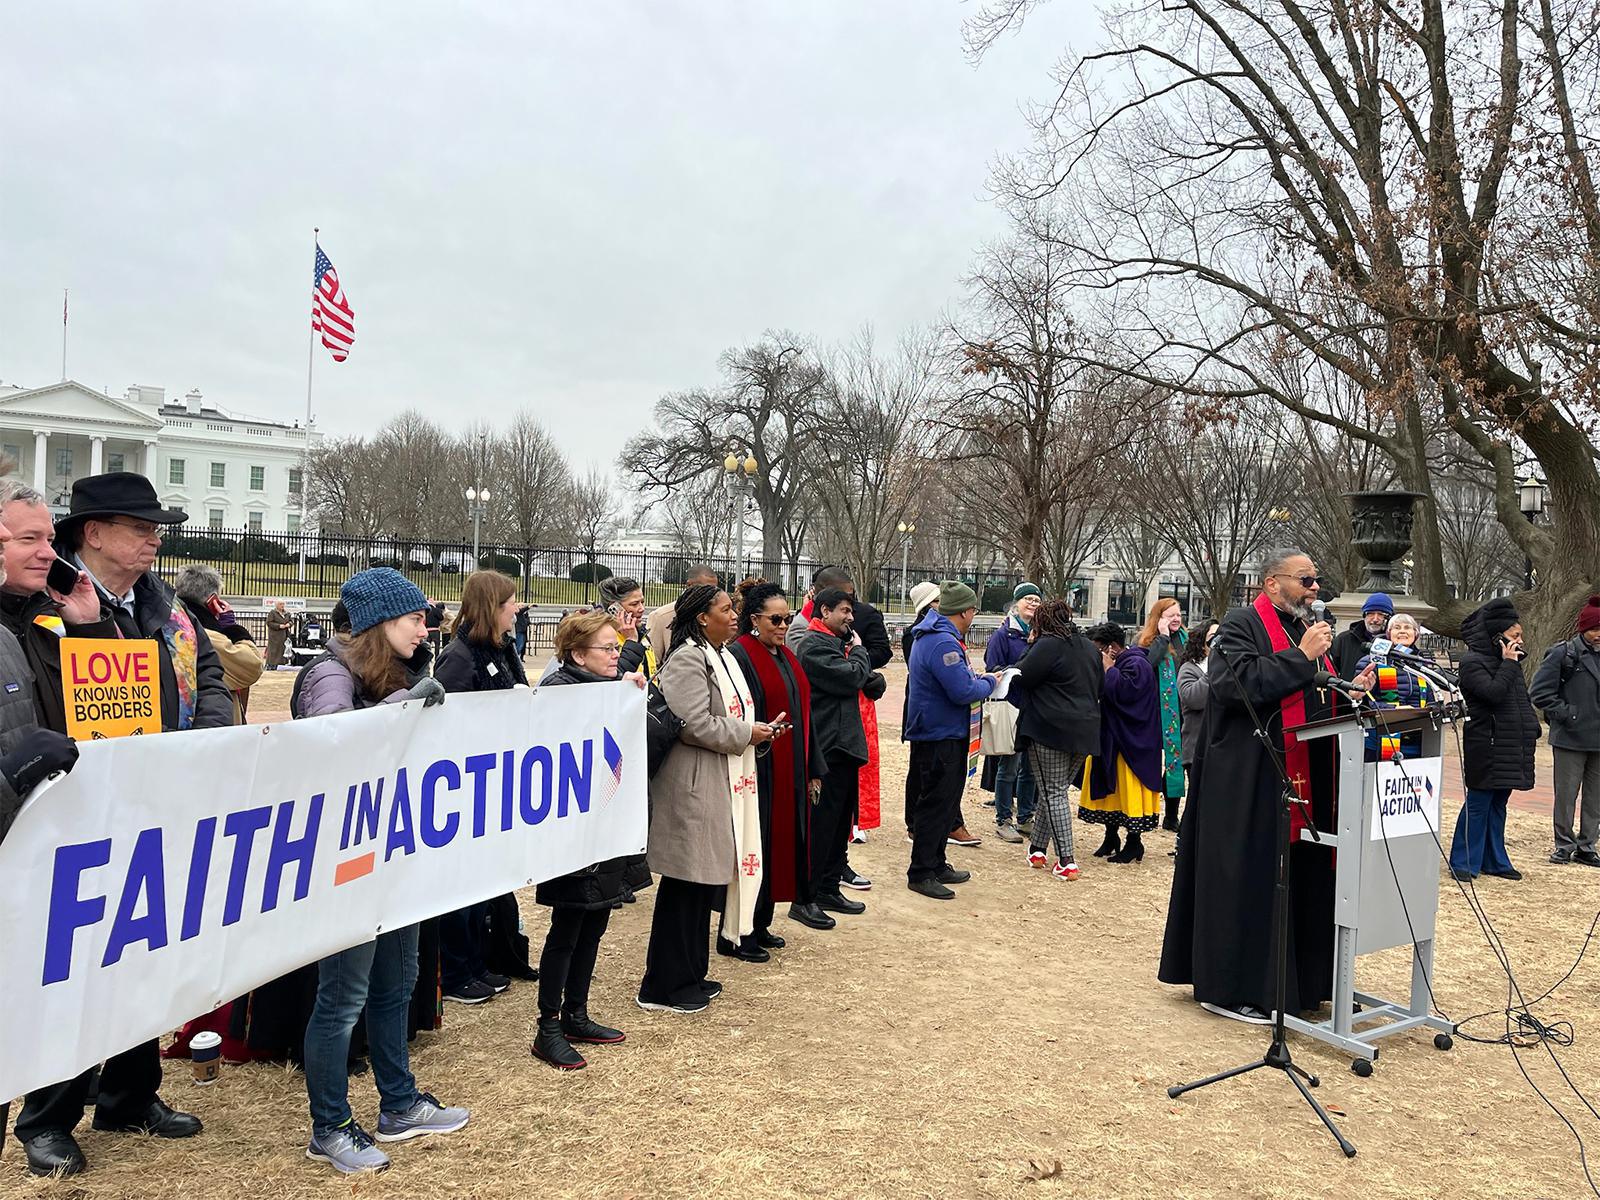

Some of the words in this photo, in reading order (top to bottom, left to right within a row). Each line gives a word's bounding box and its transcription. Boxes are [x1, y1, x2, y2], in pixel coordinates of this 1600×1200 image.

[71, 652, 150, 684] LOVE
[73, 686, 129, 702] KNOWS
[131, 685, 151, 700] NO
[75, 701, 153, 722] BORDERS
[1385, 776, 1414, 796] FAITH
[1414, 776, 1422, 787] IN
[1382, 795, 1421, 816] ACTION
[42, 793, 325, 986] FAITH
[339, 777, 385, 850] IN
[384, 739, 593, 863] ACTION
